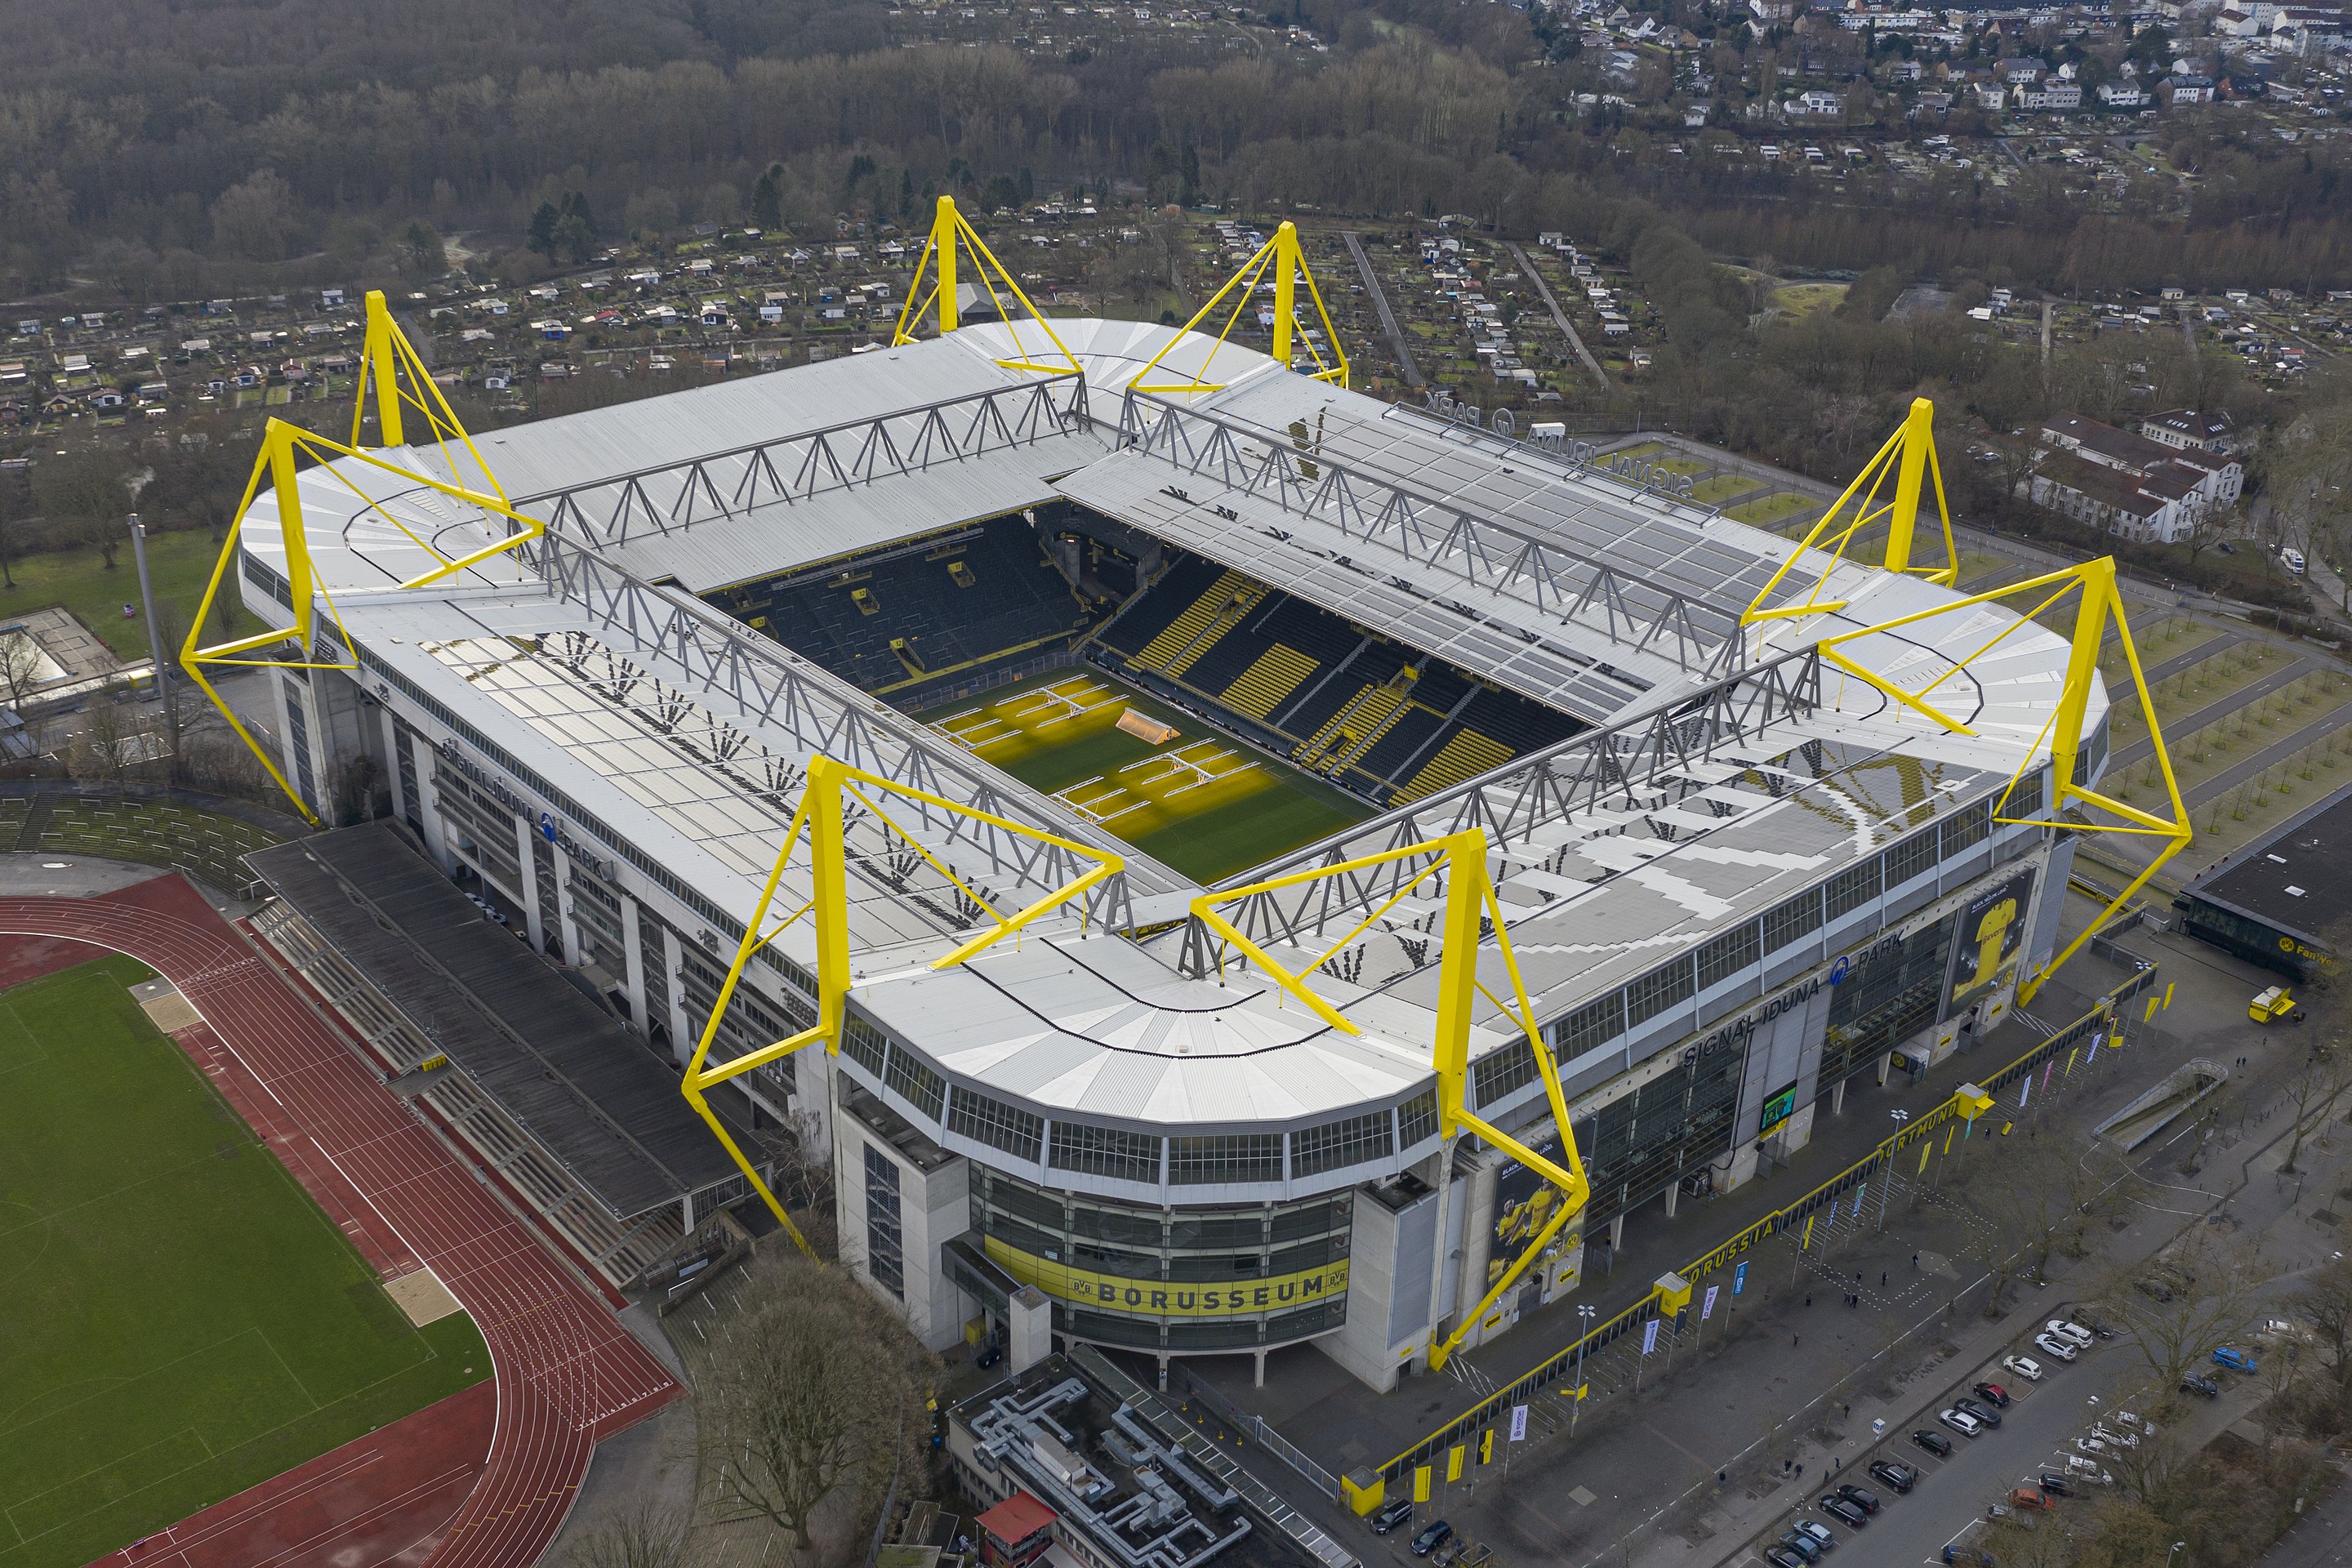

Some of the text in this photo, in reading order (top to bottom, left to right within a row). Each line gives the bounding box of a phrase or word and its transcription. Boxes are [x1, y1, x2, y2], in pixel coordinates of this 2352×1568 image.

[443, 742, 605, 882] SIGNAL IDUNA PARK
[1683, 928, 1905, 1069] SIGNAL IDUNA PARK
[1878, 1101, 1957, 1164] DORTMUND
[1330, 1270, 1345, 1285] BVB
[1683, 1220, 1772, 1284] ORUSSIA
[1073, 1279, 1090, 1294] BVB
[1098, 1275, 1322, 1310] BORUSSEUM
